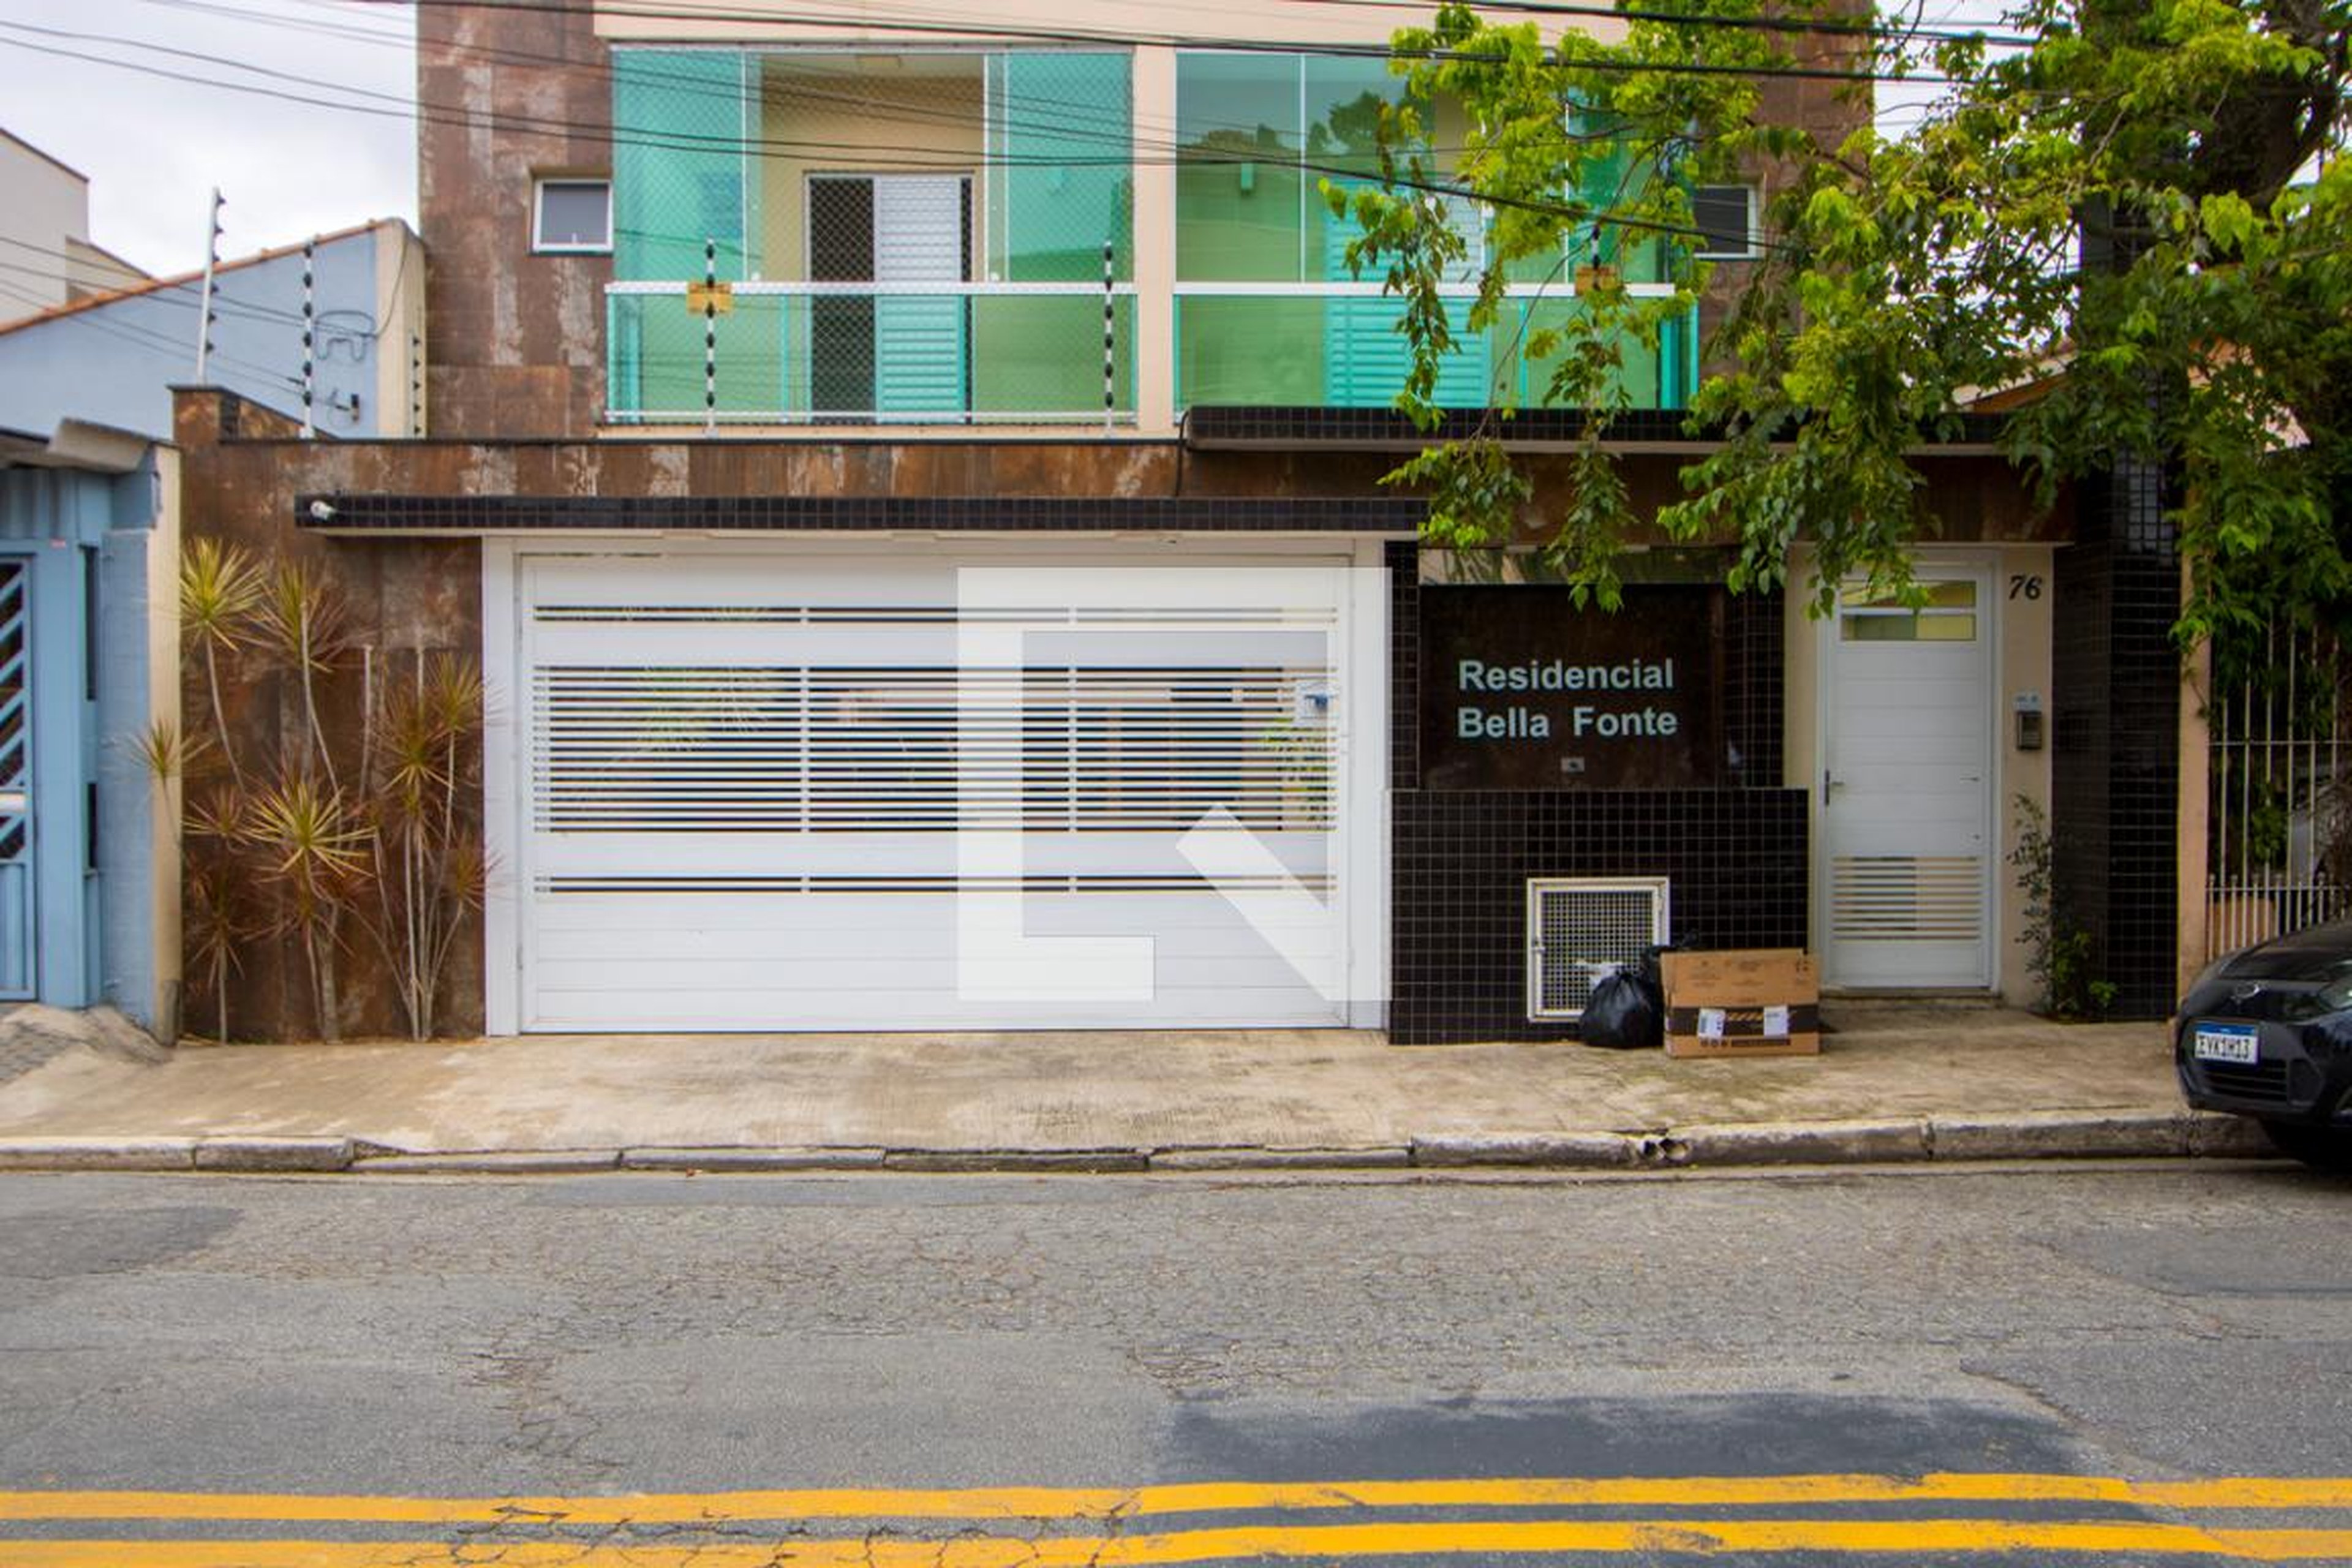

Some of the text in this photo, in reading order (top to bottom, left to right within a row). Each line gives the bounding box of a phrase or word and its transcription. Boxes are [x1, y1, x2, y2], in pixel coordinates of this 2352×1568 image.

[2010, 575, 2042, 600] 76
[1459, 658, 1673, 690] Residencial
[1458, 706, 1678, 737] Bella Fonte
